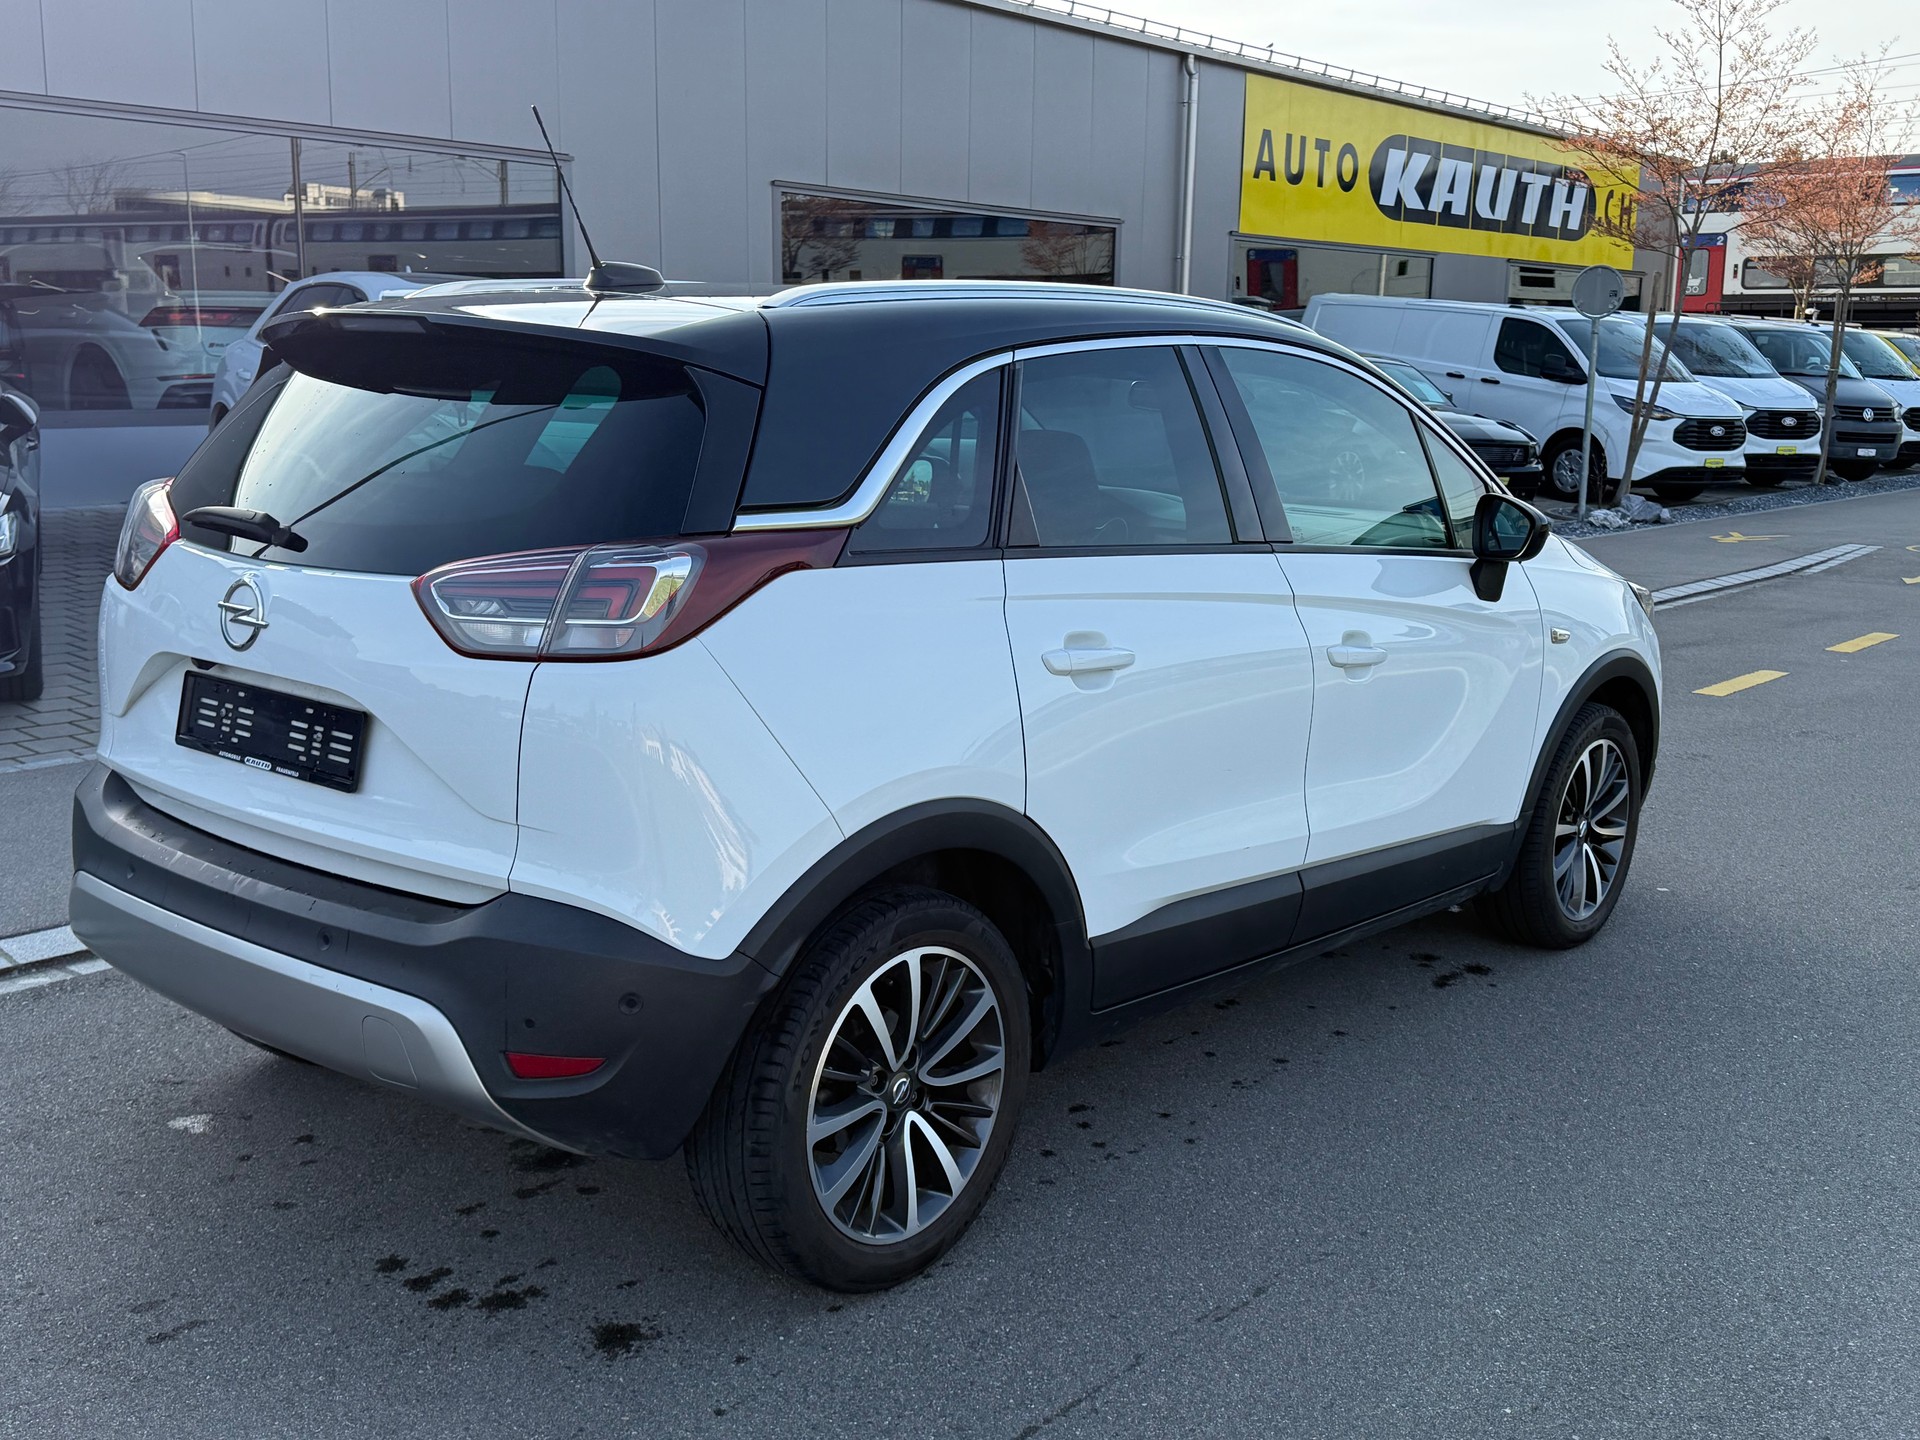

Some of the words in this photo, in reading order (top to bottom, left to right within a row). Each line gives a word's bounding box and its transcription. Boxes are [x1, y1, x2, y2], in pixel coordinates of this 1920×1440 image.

[1252, 128, 1358, 192] AUTO
[1379, 148, 1588, 231] KAUTH
[1716, 235, 1724, 246] 2
[246, 757, 270, 769] KAUTH
